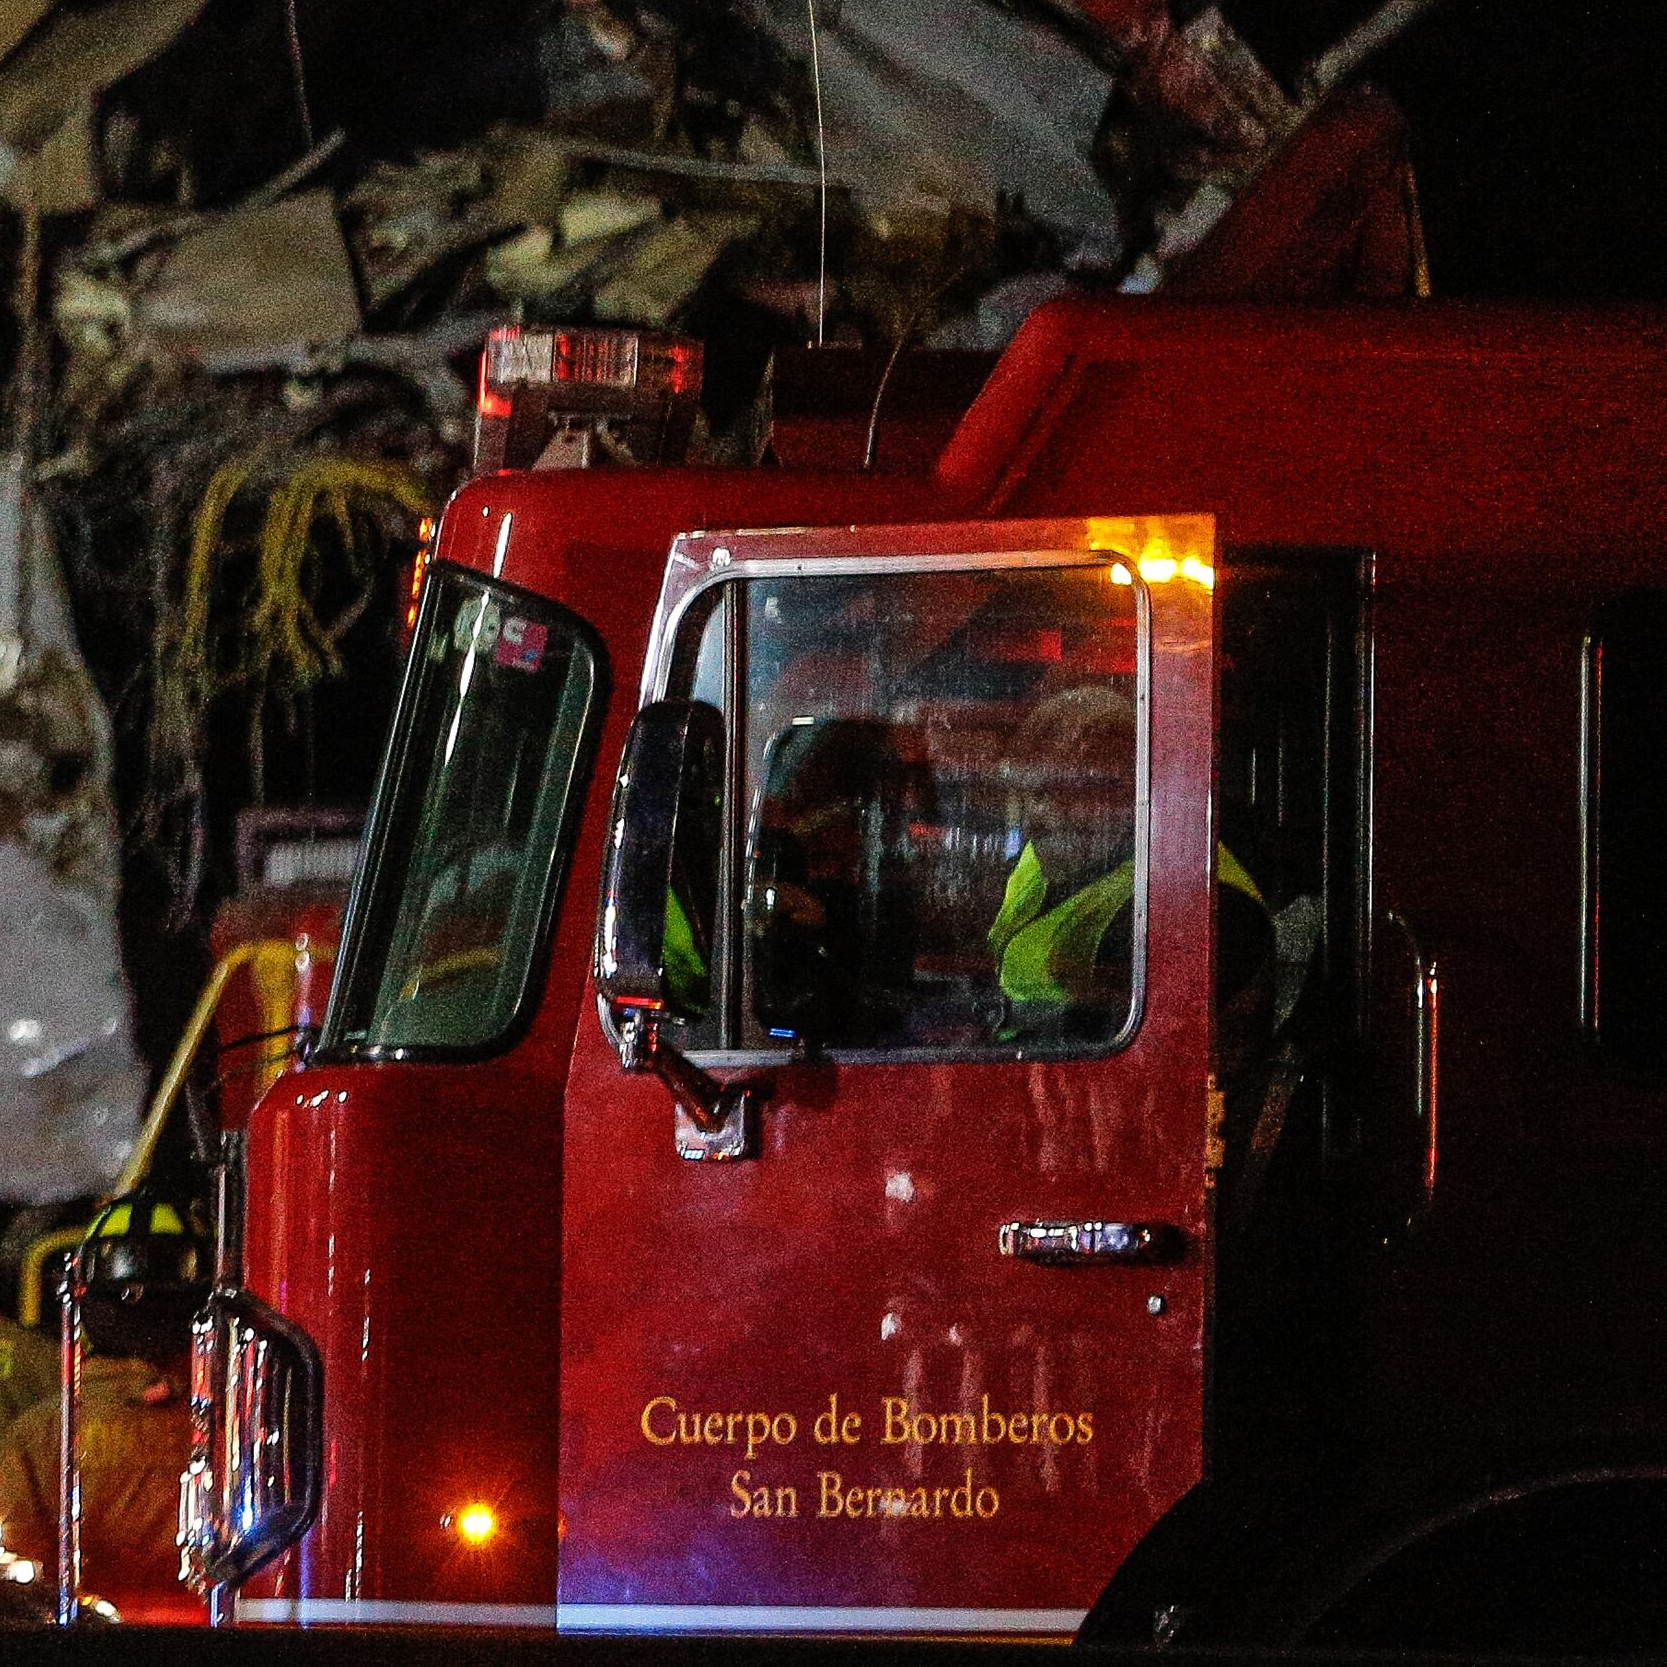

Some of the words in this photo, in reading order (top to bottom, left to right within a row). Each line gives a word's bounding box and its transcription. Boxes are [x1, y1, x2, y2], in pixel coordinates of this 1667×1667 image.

[640, 1395, 798, 1460] Cuerpo
[813, 1393, 863, 1445] de
[879, 1393, 1095, 1446] Bomberos
[730, 1469, 798, 1519] San
[816, 1469, 1000, 1519] Bernardo
